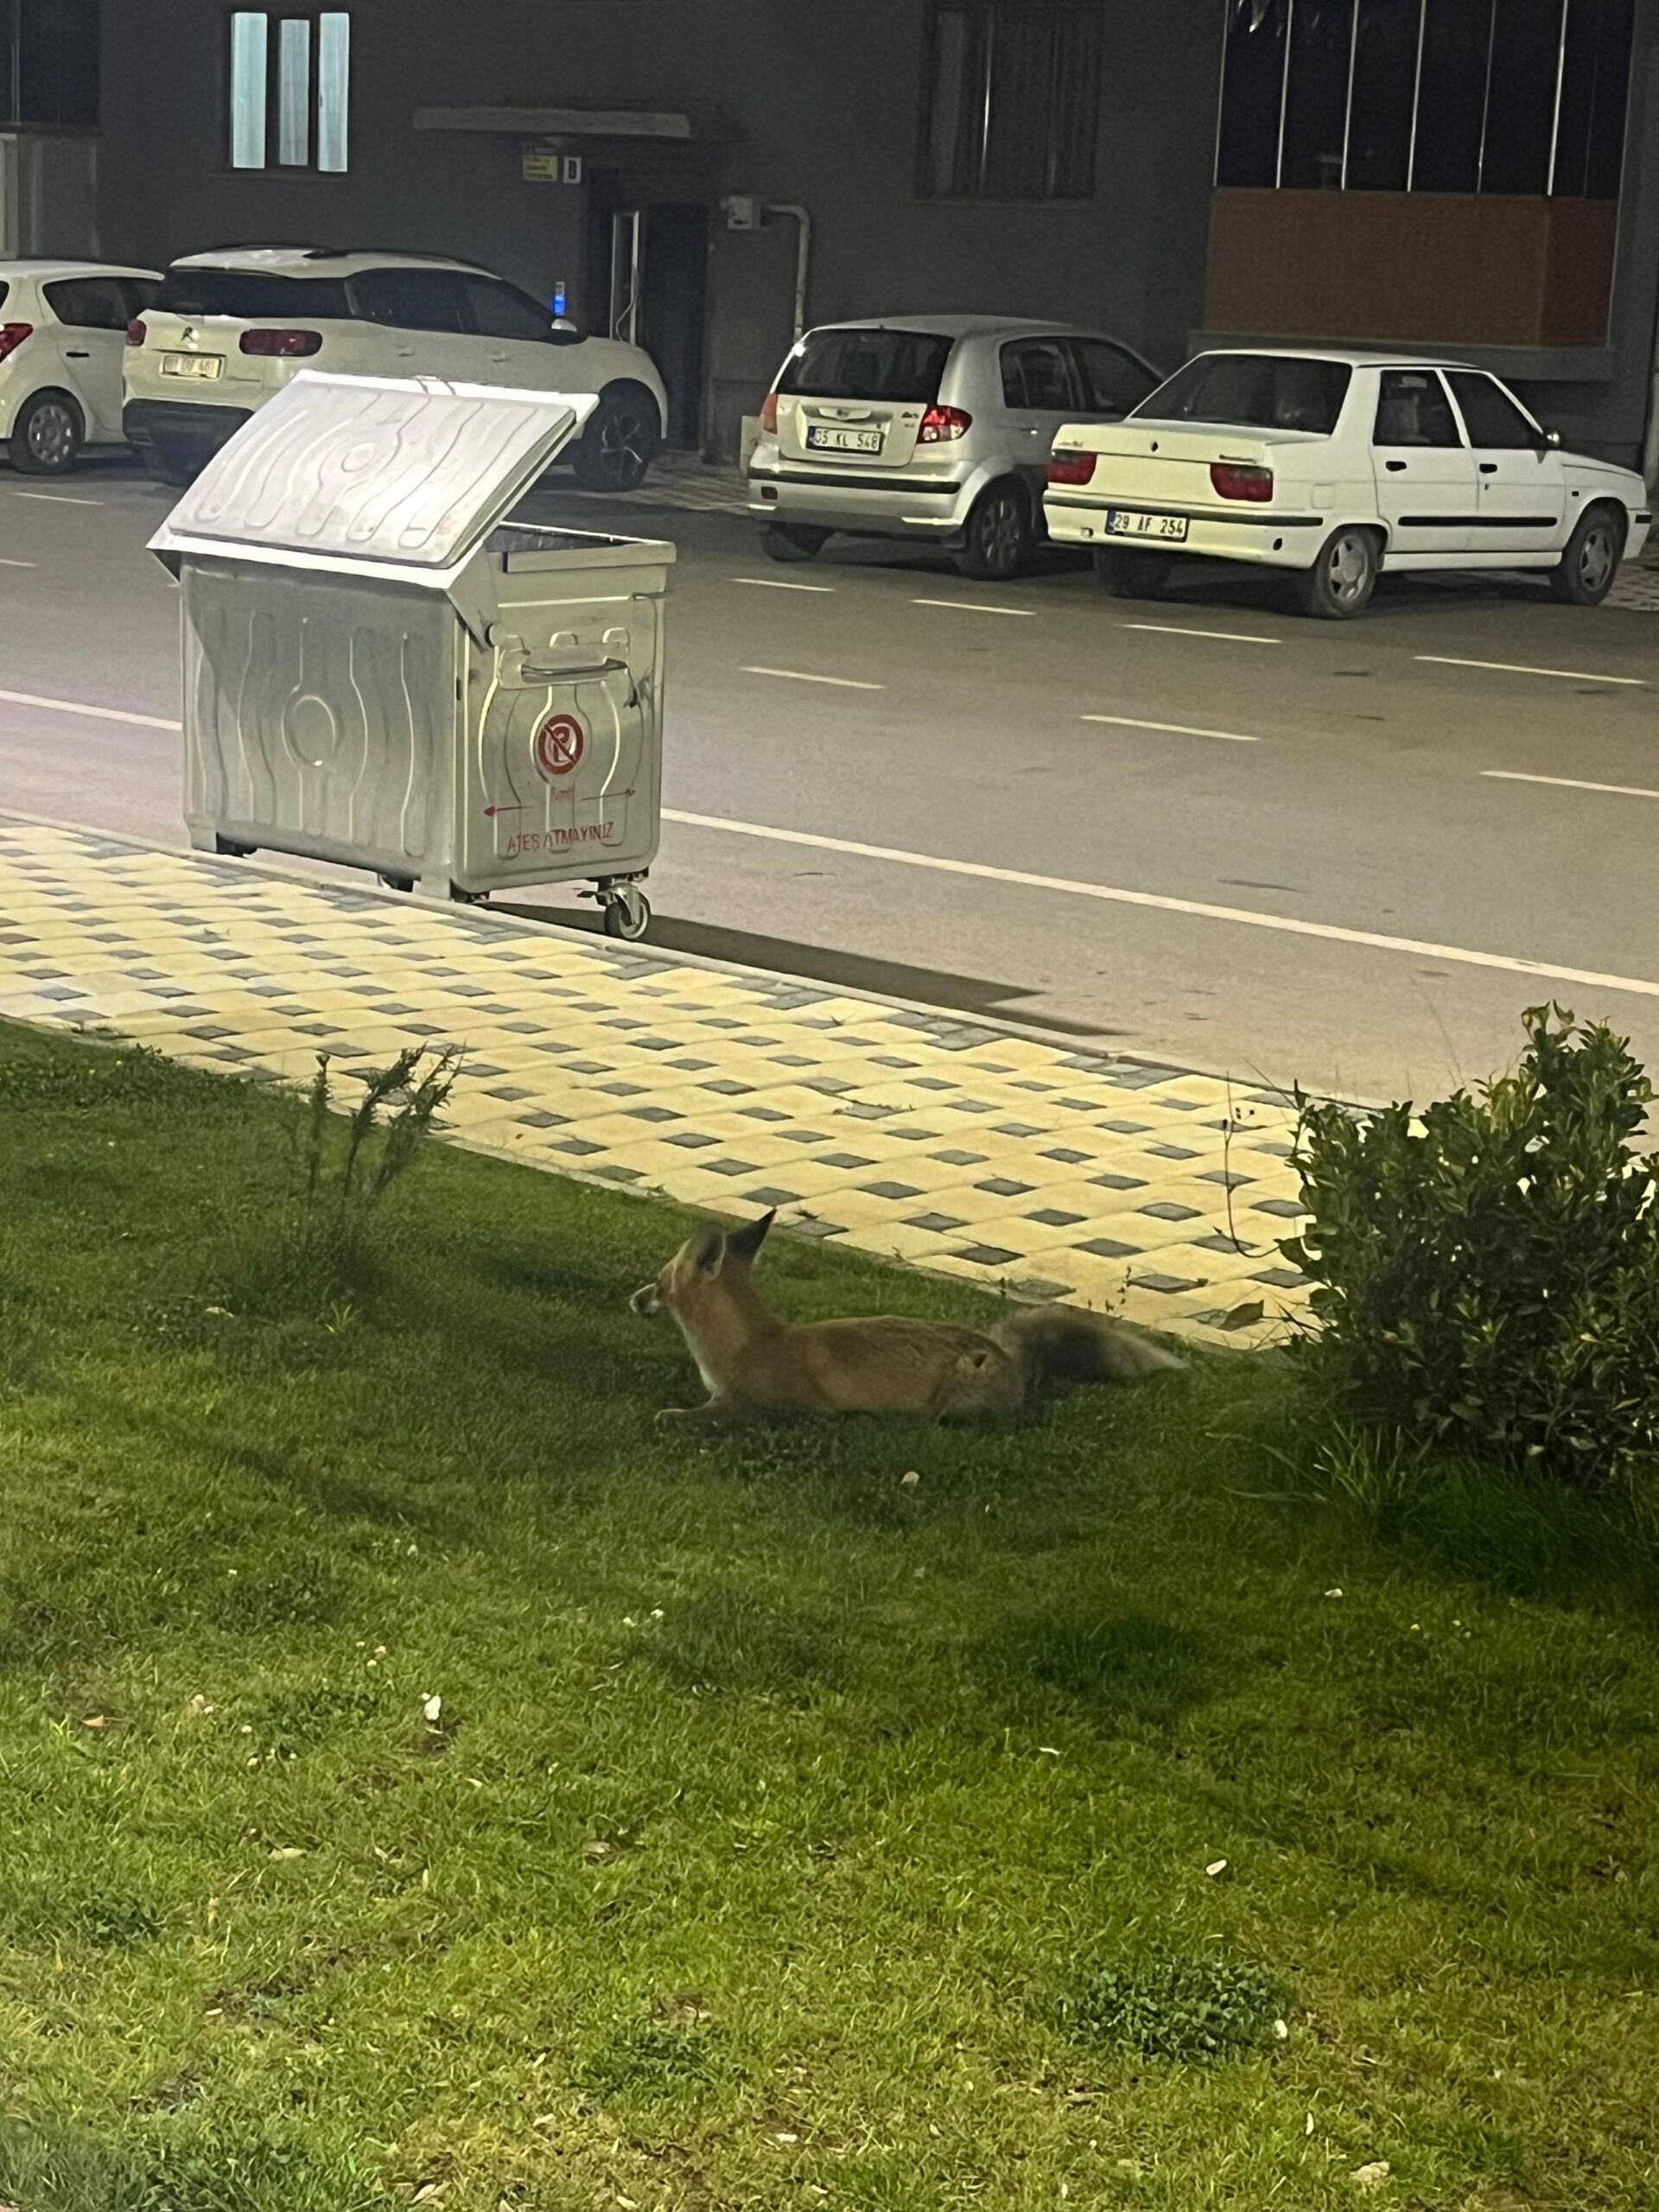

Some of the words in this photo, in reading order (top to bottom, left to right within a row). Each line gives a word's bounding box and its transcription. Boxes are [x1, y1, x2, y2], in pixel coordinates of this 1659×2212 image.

[857, 434, 879, 449] 548
[1115, 513, 1129, 530] 29
[1137, 516, 1153, 532] AF
[1160, 518, 1183, 535] 254
